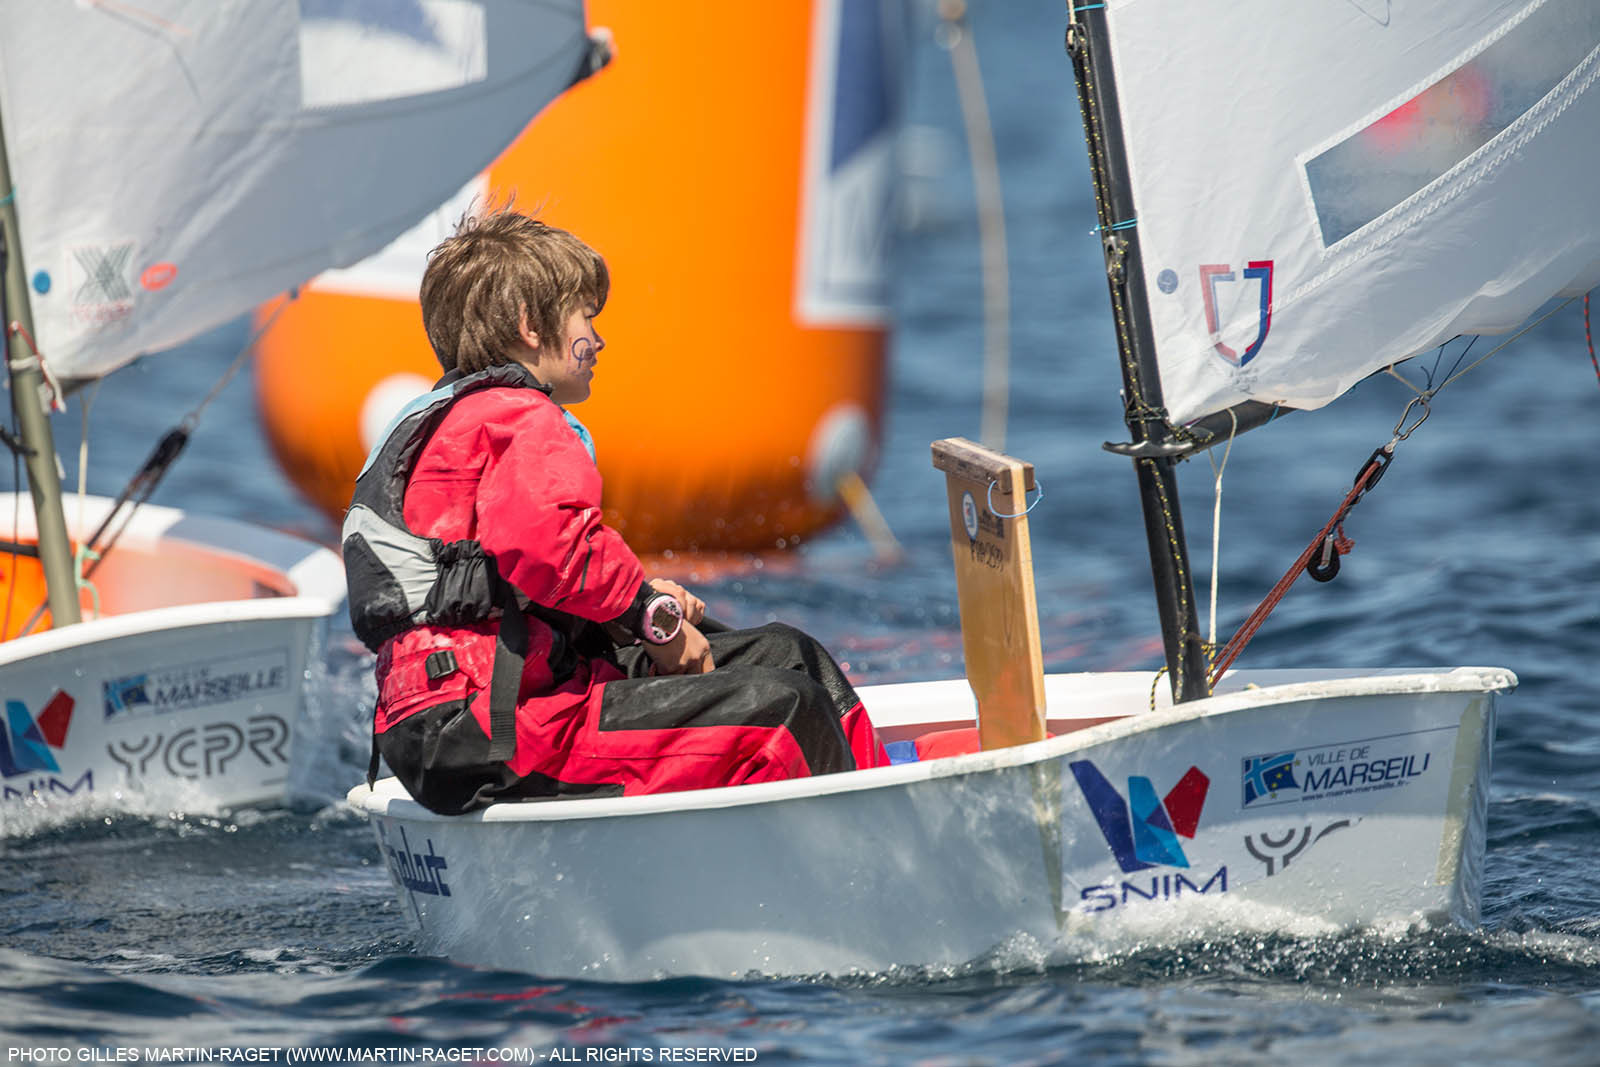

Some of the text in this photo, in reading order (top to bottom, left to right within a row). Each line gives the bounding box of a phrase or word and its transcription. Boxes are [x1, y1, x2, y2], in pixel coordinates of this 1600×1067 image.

[107, 714, 290, 780] YCPR
[1308, 745, 1371, 767] VILLE DE
[1081, 865, 1227, 912] SNIM
